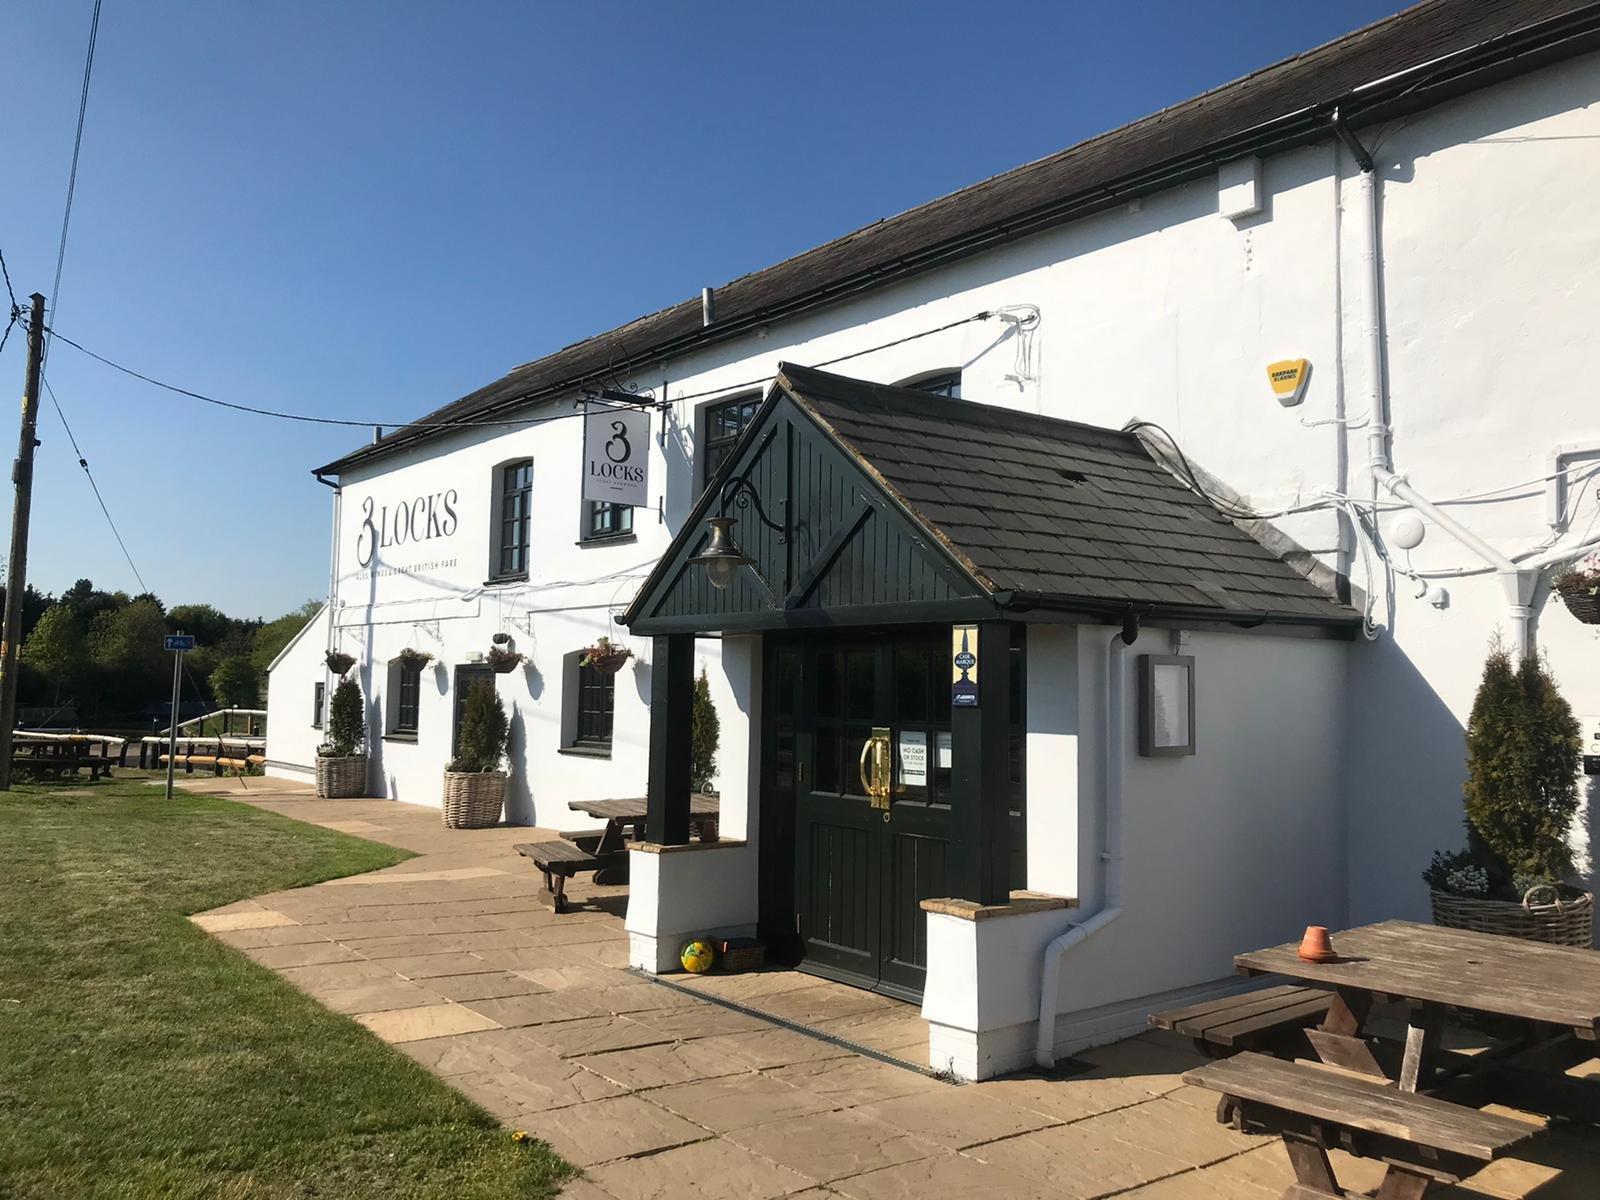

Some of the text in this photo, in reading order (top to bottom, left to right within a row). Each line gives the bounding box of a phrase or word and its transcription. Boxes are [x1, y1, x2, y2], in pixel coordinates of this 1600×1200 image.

[605, 420, 631, 464] 3
[590, 460, 644, 482] LOCKS
[356, 489, 458, 568] 3 LOCKS
[413, 561, 439, 572] BRITISH
[441, 558, 457, 568] FARE
